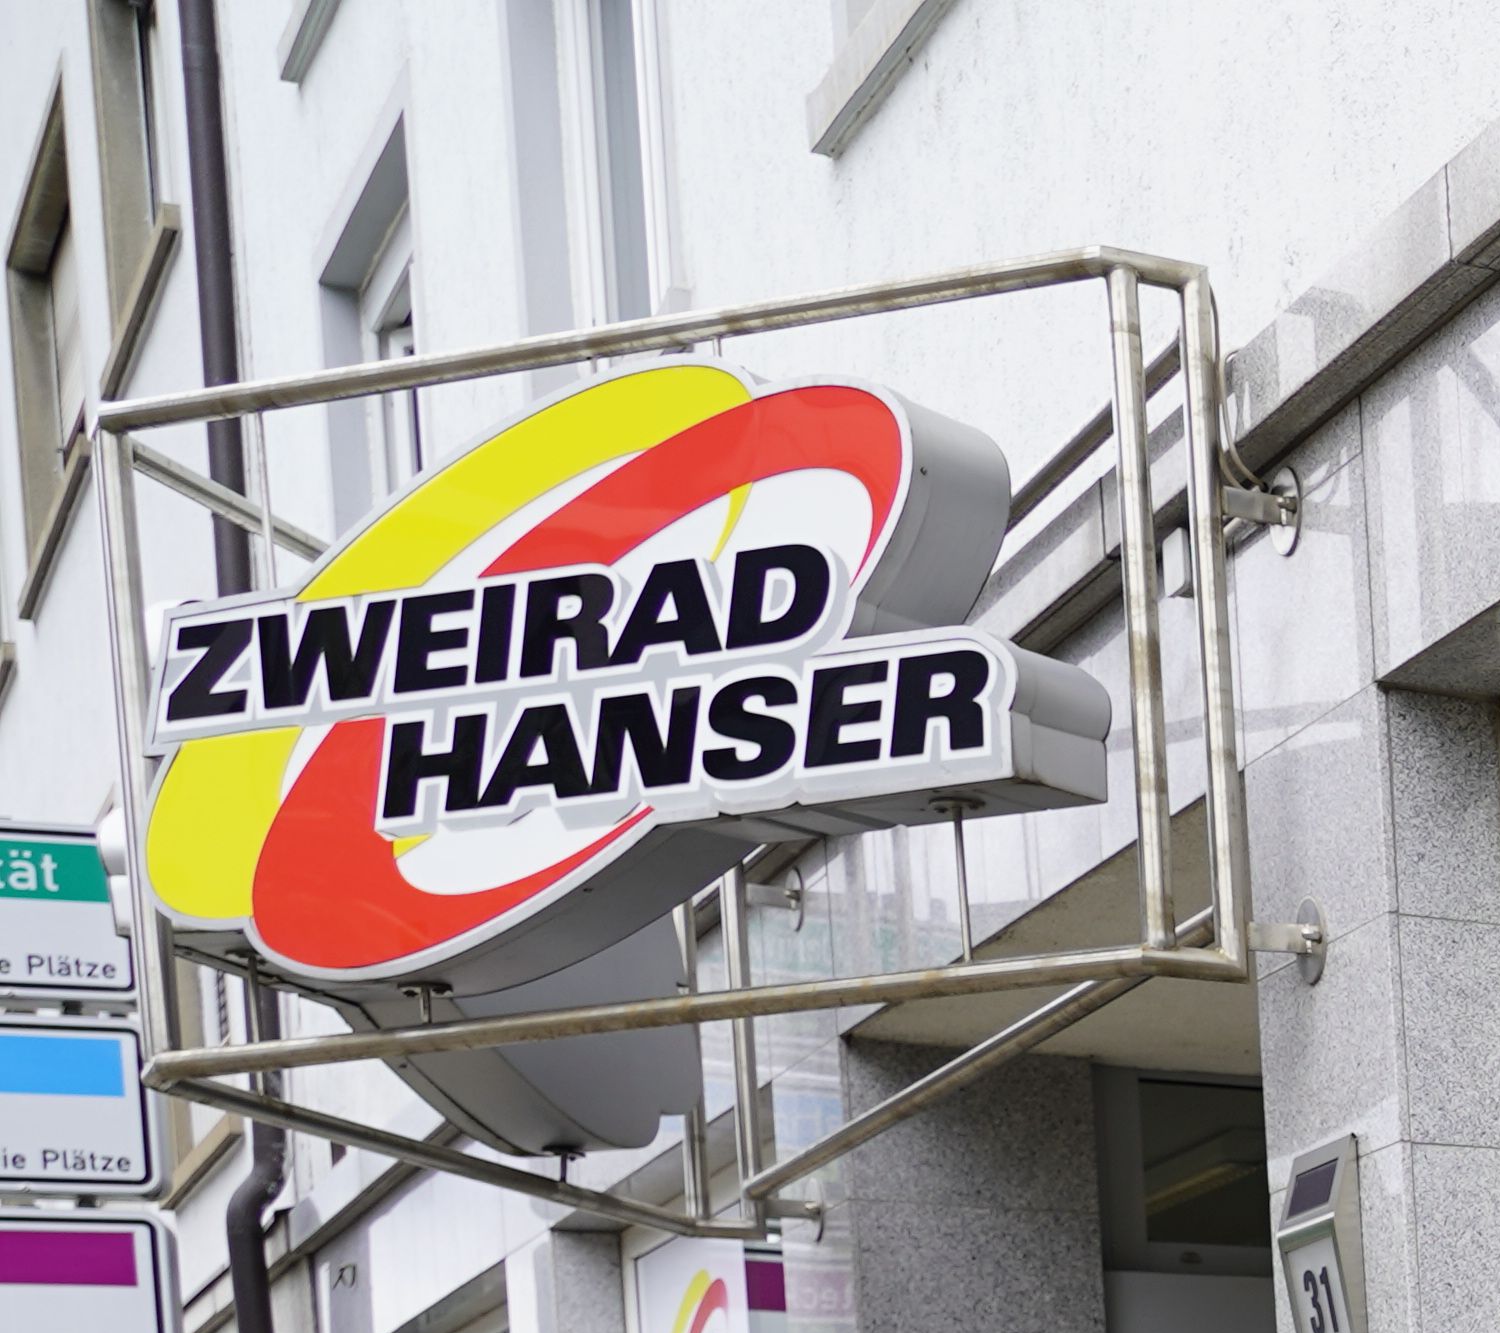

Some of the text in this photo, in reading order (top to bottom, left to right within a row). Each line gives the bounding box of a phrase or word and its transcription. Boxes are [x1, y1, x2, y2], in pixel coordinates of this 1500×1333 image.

[166, 543, 831, 723] ZWEIRAD
[383, 650, 990, 818] HANSER
[28, 955, 117, 979] Plätze
[42, 1150, 131, 1173] Plätze
